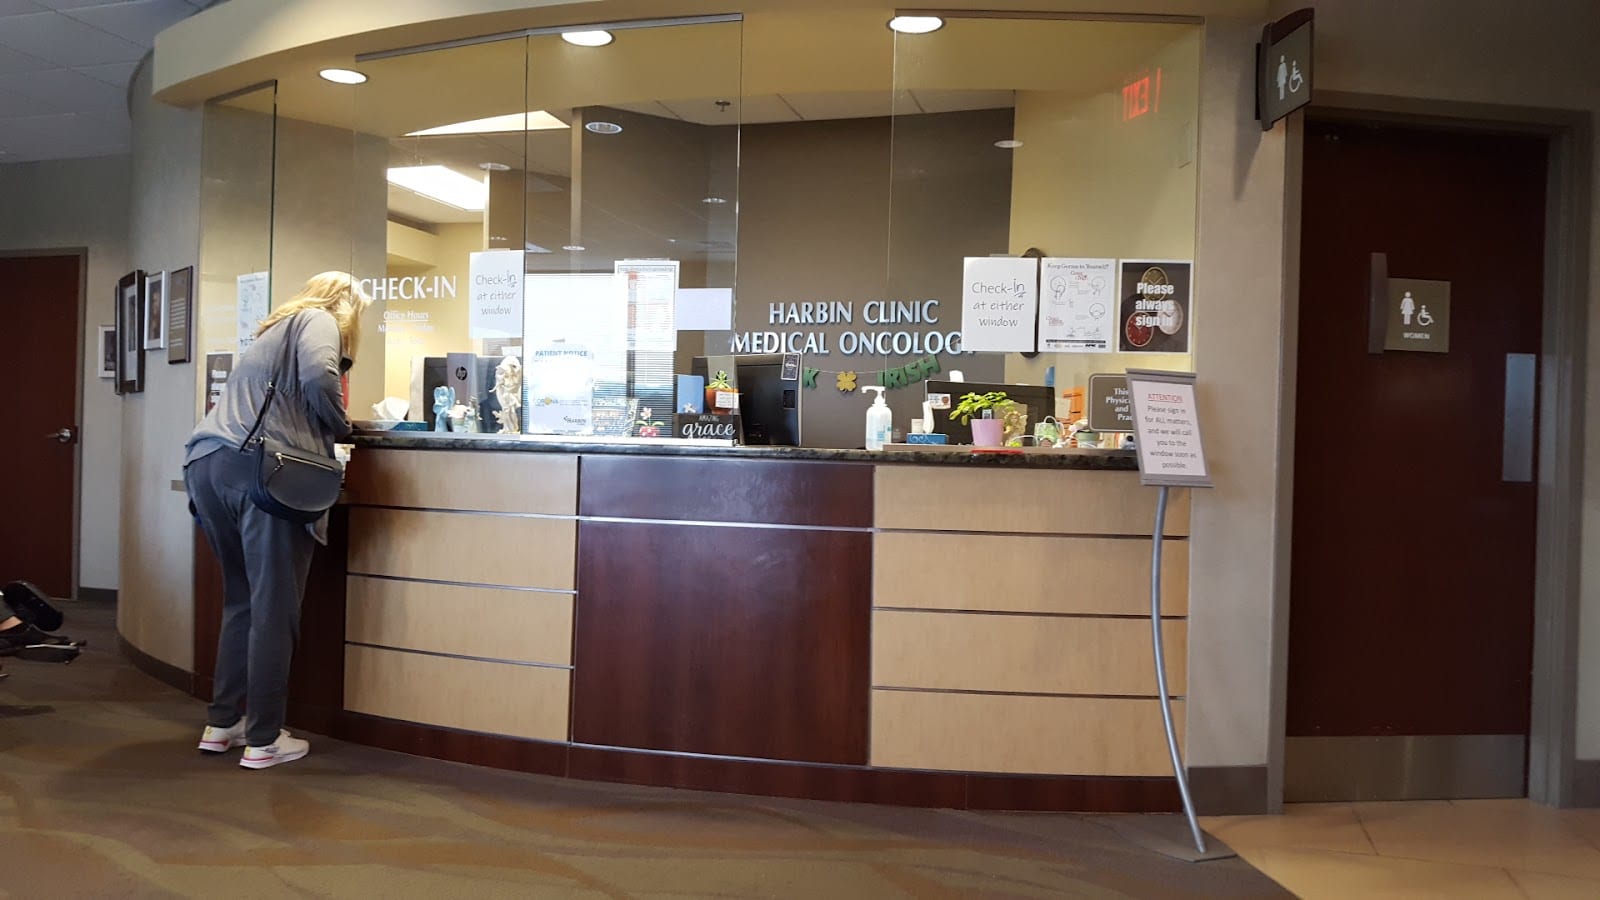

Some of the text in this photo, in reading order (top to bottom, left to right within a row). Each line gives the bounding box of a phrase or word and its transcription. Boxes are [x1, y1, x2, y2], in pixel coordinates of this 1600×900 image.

[359, 275, 457, 300] CHECK-IN
[972, 278, 1026, 297] Check-in
[1136, 282, 1174, 295] Please
[476, 290, 517, 301] at either
[481, 304, 512, 315] window
[972, 300, 1025, 311] at either
[1135, 298, 1175, 311] always
[769, 300, 939, 325] HARBIN CLINIC
[978, 316, 1018, 327] window
[1135, 314, 1160, 327] sign
[730, 331, 974, 355] MEDICAL ONCOLOG
[877, 354, 941, 390] IRISH
[1147, 393, 1184, 402] ATTENTION
[1114, 404, 1129, 412] and
[682, 422, 736, 439] grace
[1161, 461, 1187, 469] possible.
